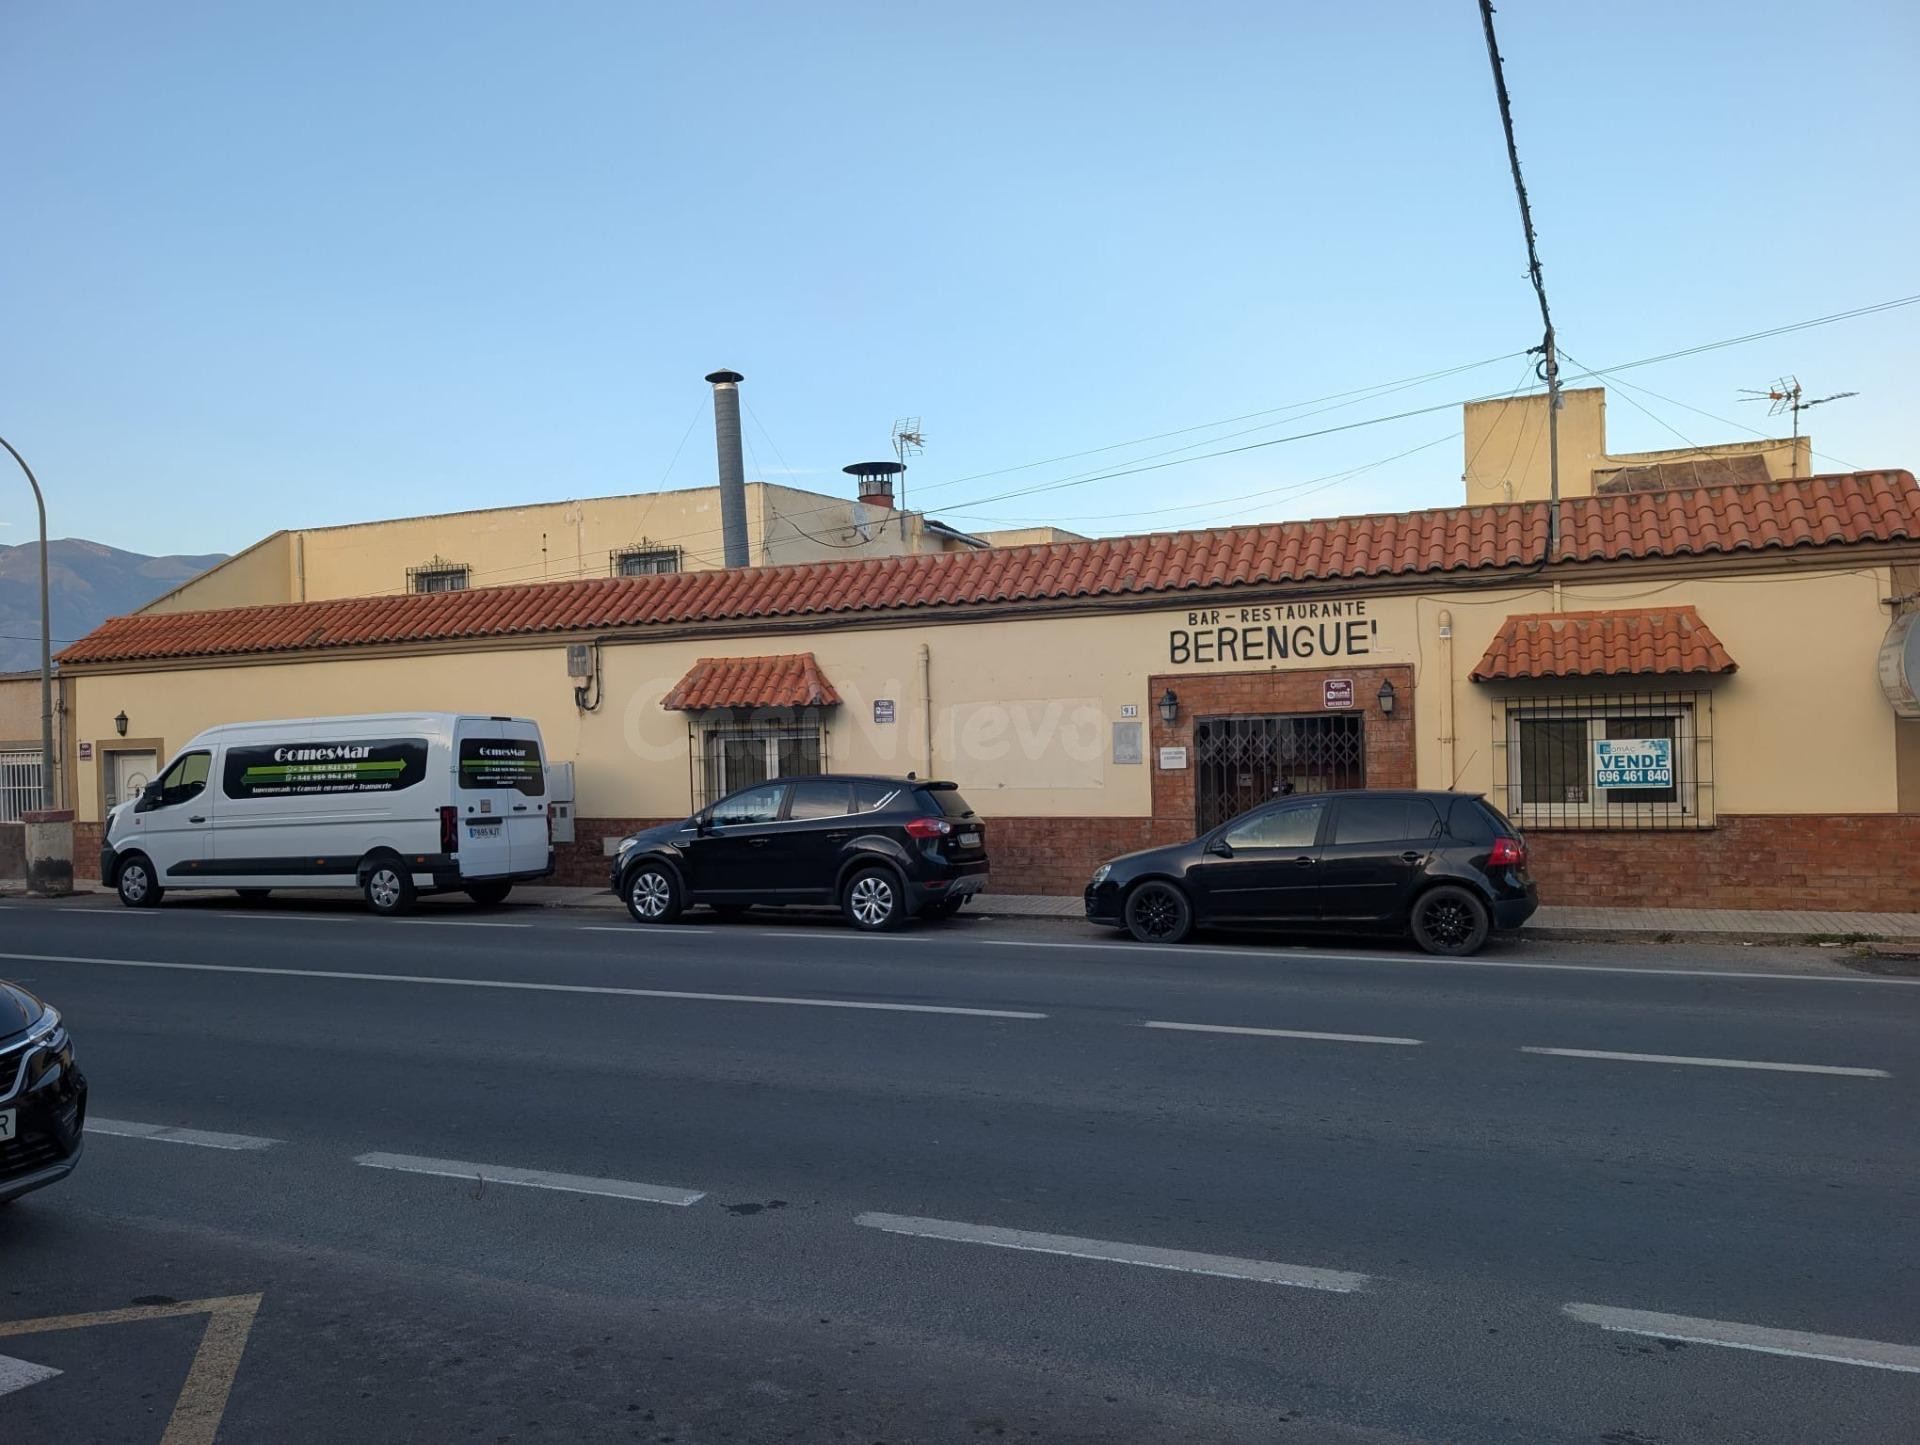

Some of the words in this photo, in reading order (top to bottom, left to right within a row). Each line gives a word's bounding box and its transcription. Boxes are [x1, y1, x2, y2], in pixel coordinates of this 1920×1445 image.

[1123, 706, 1135, 716] 91
[274, 745, 374, 763] GomesMar
[1600, 754, 1667, 769] VENDE
[1599, 771, 1620, 783] 696
[1622, 770, 1643, 782] 461
[1647, 769, 1668, 781] 840
